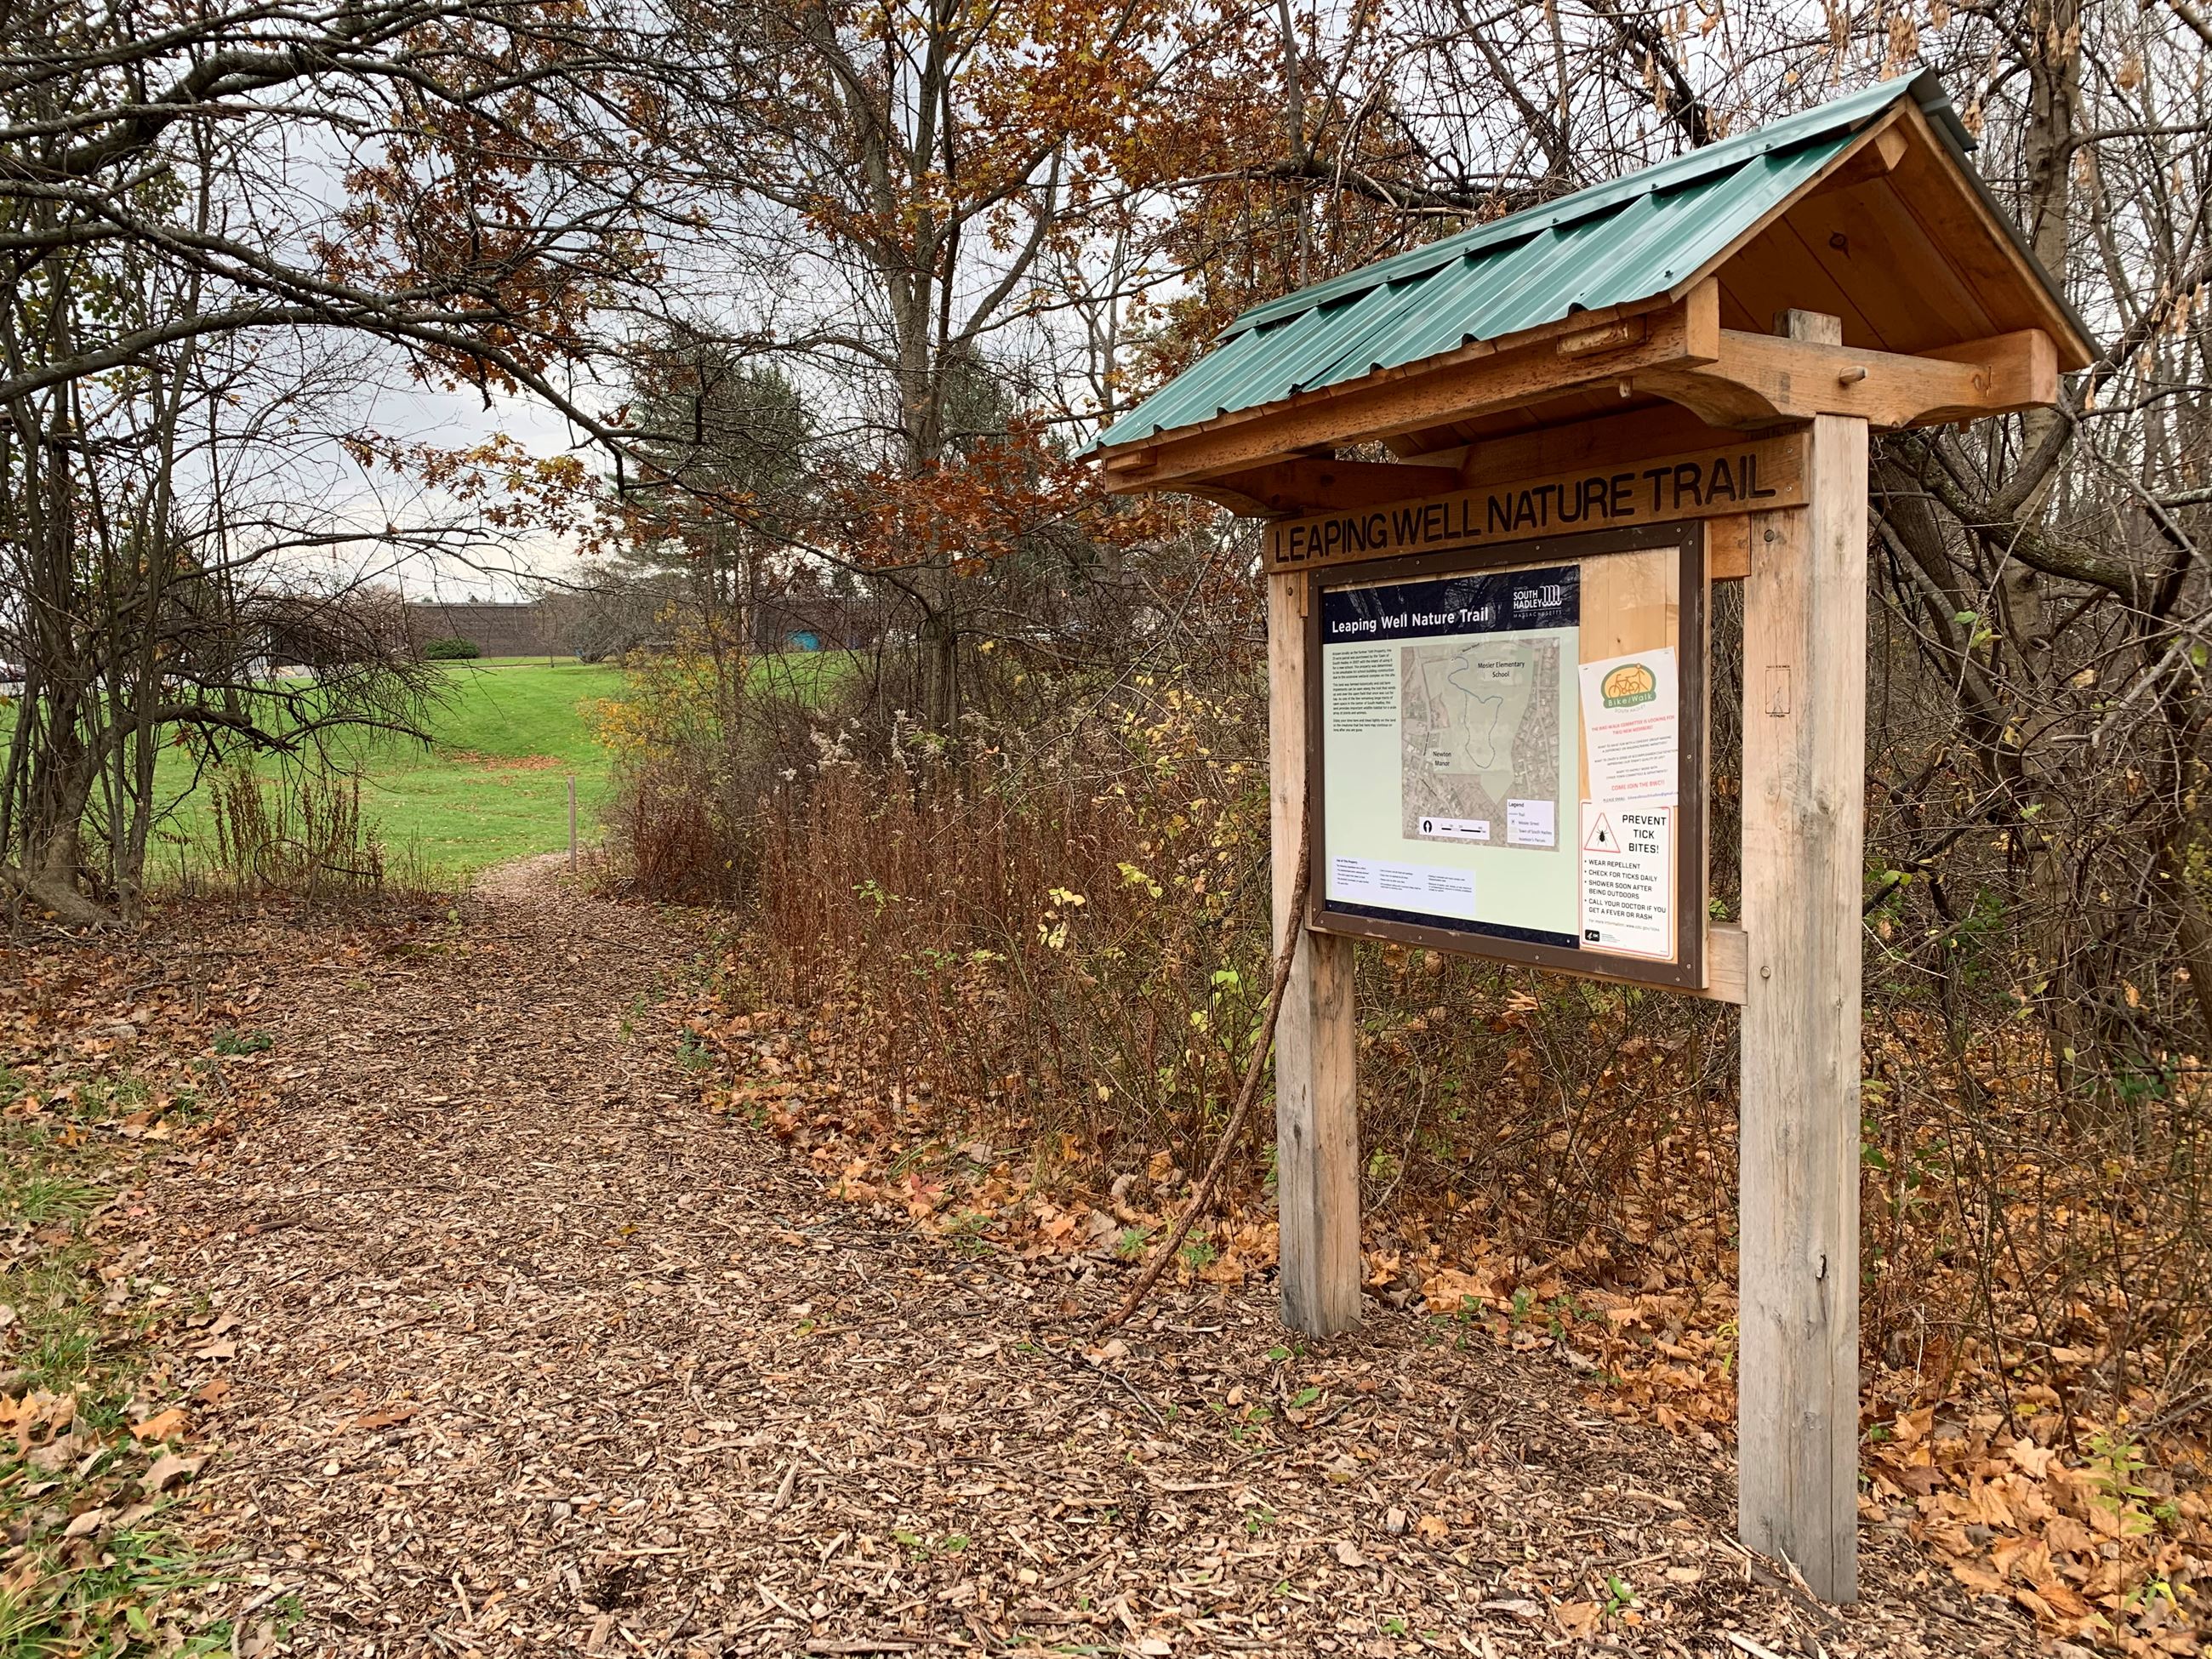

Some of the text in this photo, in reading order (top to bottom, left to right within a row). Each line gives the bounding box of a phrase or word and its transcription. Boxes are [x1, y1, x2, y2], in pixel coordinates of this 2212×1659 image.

[1276, 453, 1776, 563] LEAPING WELL NATURE TRAIL
[1514, 590, 1538, 601] SOUTH
[1514, 599, 1542, 609] HADLEY
[1332, 607, 1489, 633] Leaping Well Nature Trail
[1496, 661, 1525, 670] Elementary
[1608, 693, 1653, 706] Bike/Walk
[1622, 814, 1667, 826] PREVENT
[1633, 829, 1655, 840] TICK
[1628, 842, 1659, 854] BITES!
[1607, 860, 1640, 869] REPELLENT
[1607, 890, 1639, 899] OUTDOORS
[1622, 902, 1645, 910] DOCTOR
[1606, 909, 1625, 917] FEVER
